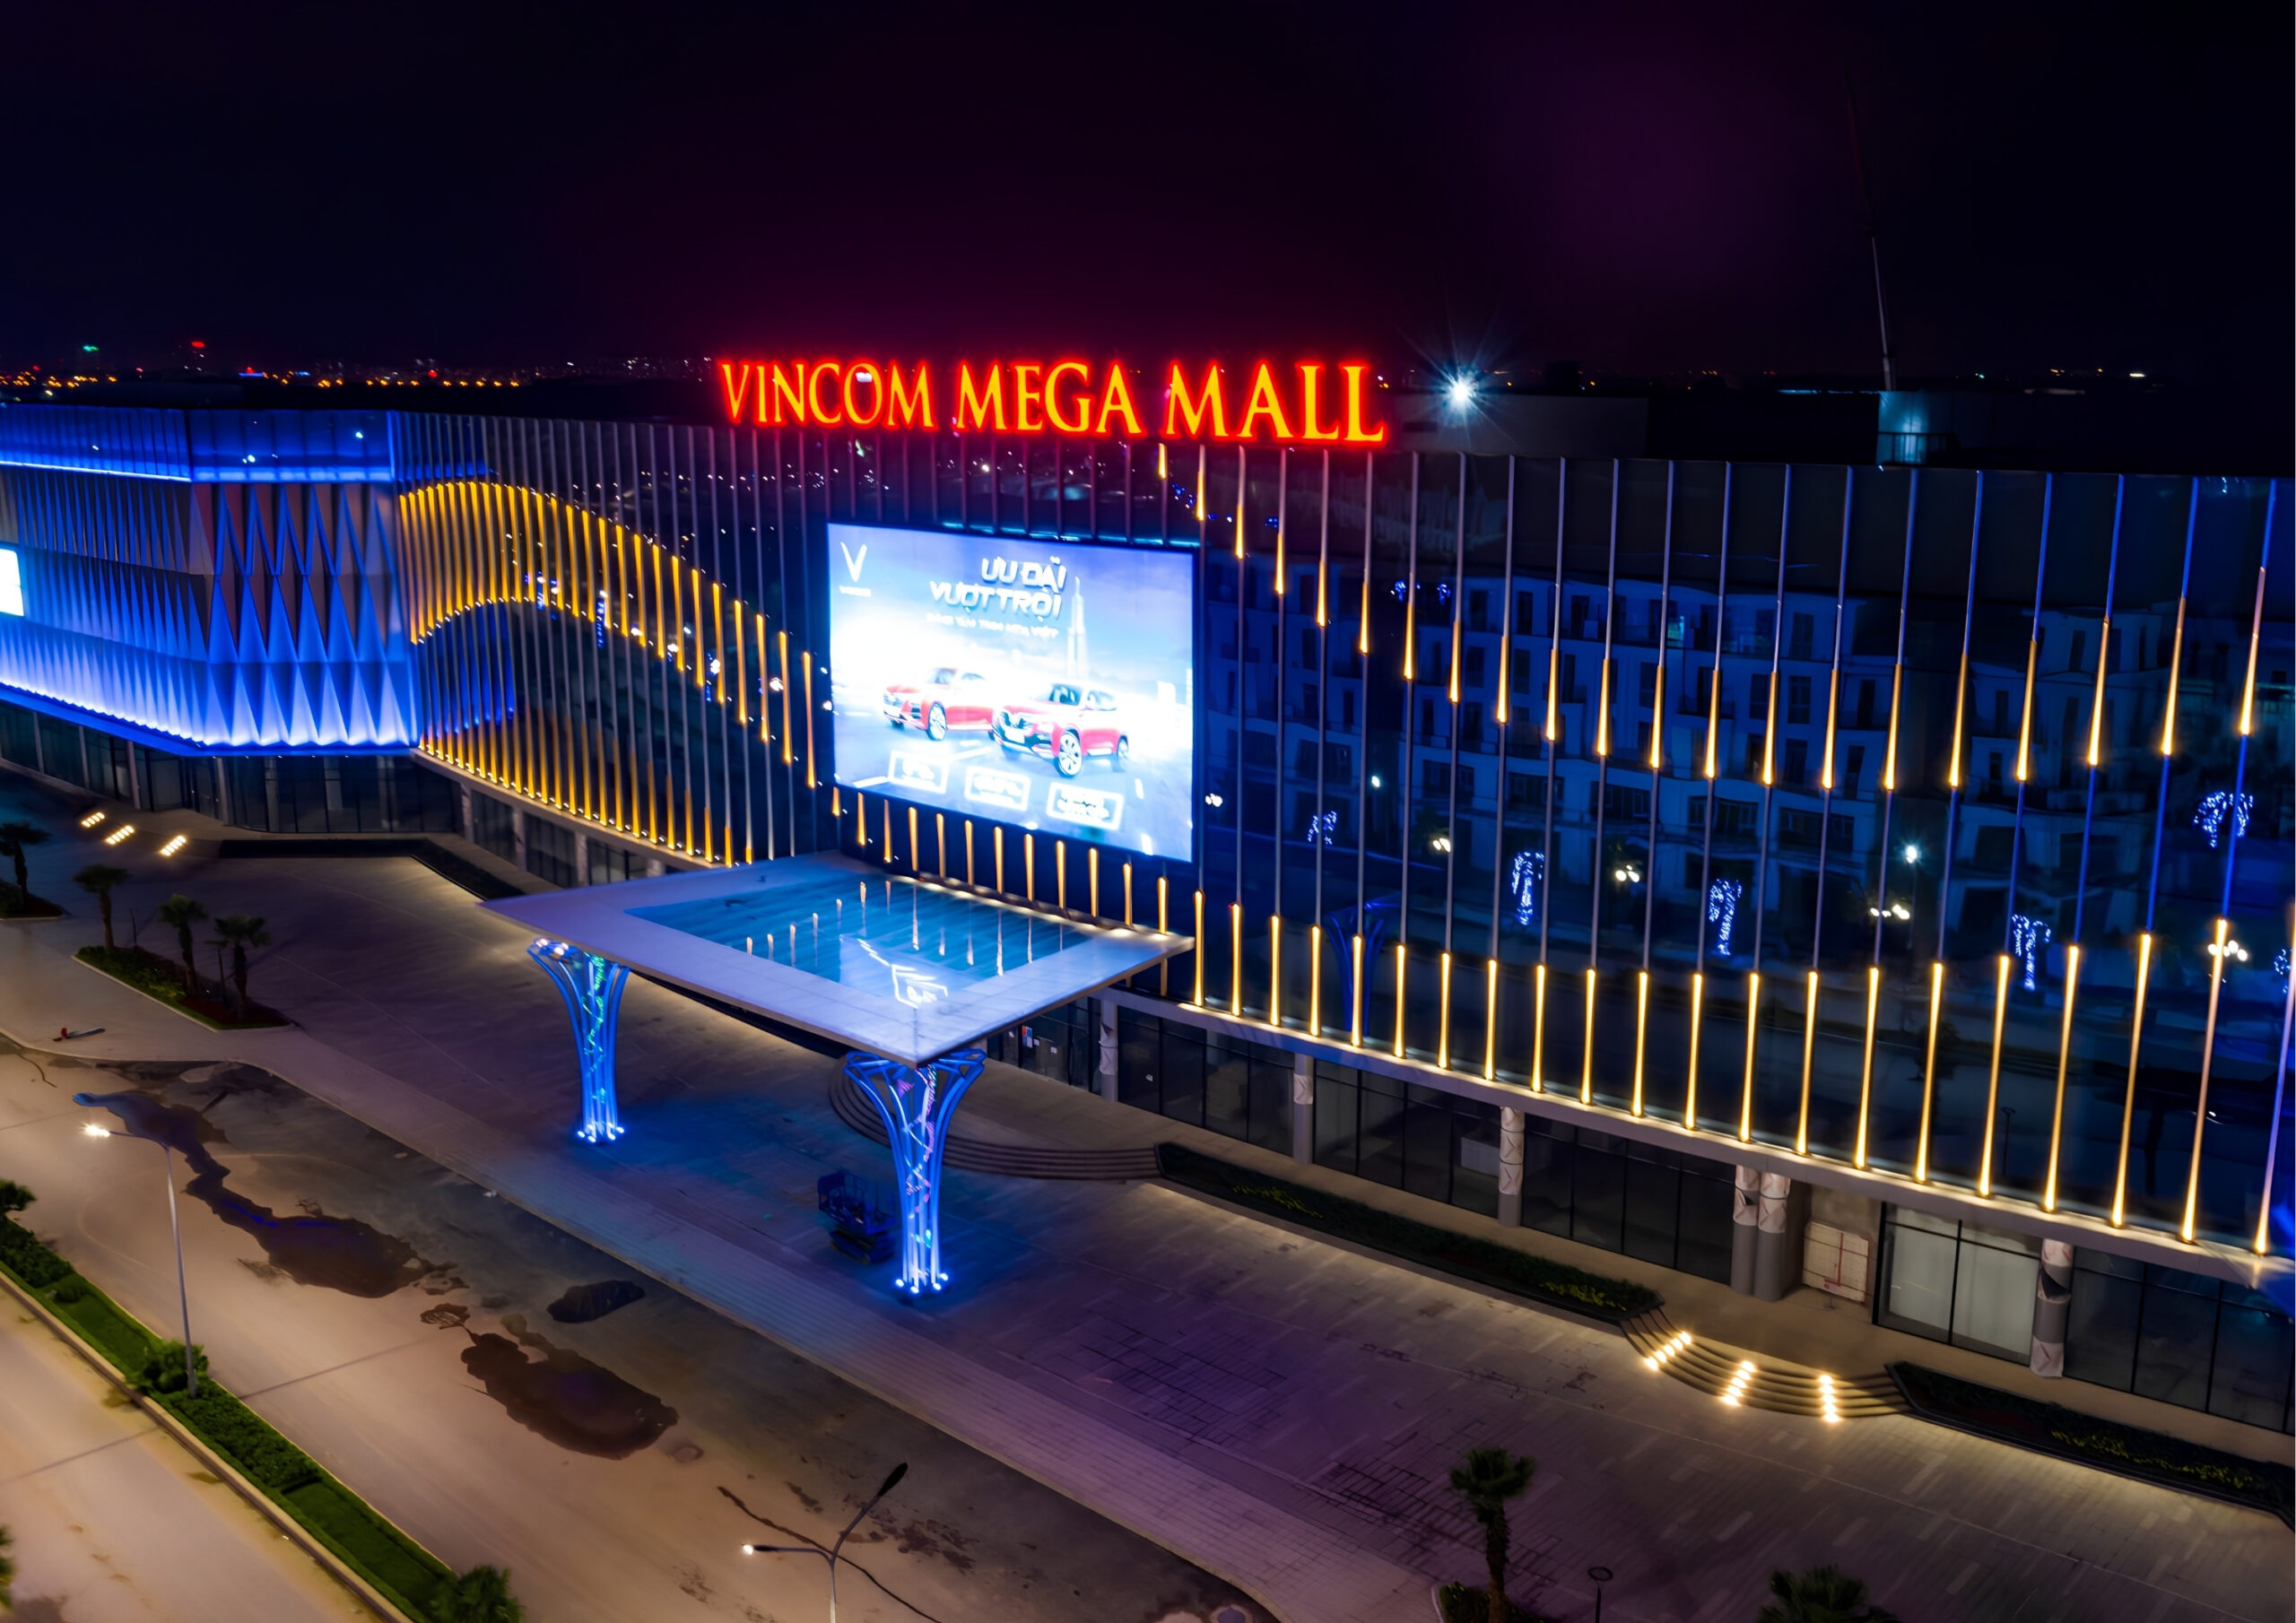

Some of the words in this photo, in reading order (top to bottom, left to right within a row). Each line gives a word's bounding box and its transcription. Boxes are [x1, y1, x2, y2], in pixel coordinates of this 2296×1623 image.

[720, 362, 935, 428] VINCOM
[955, 361, 1143, 435] MEGA
[1165, 362, 1384, 443] MALL
